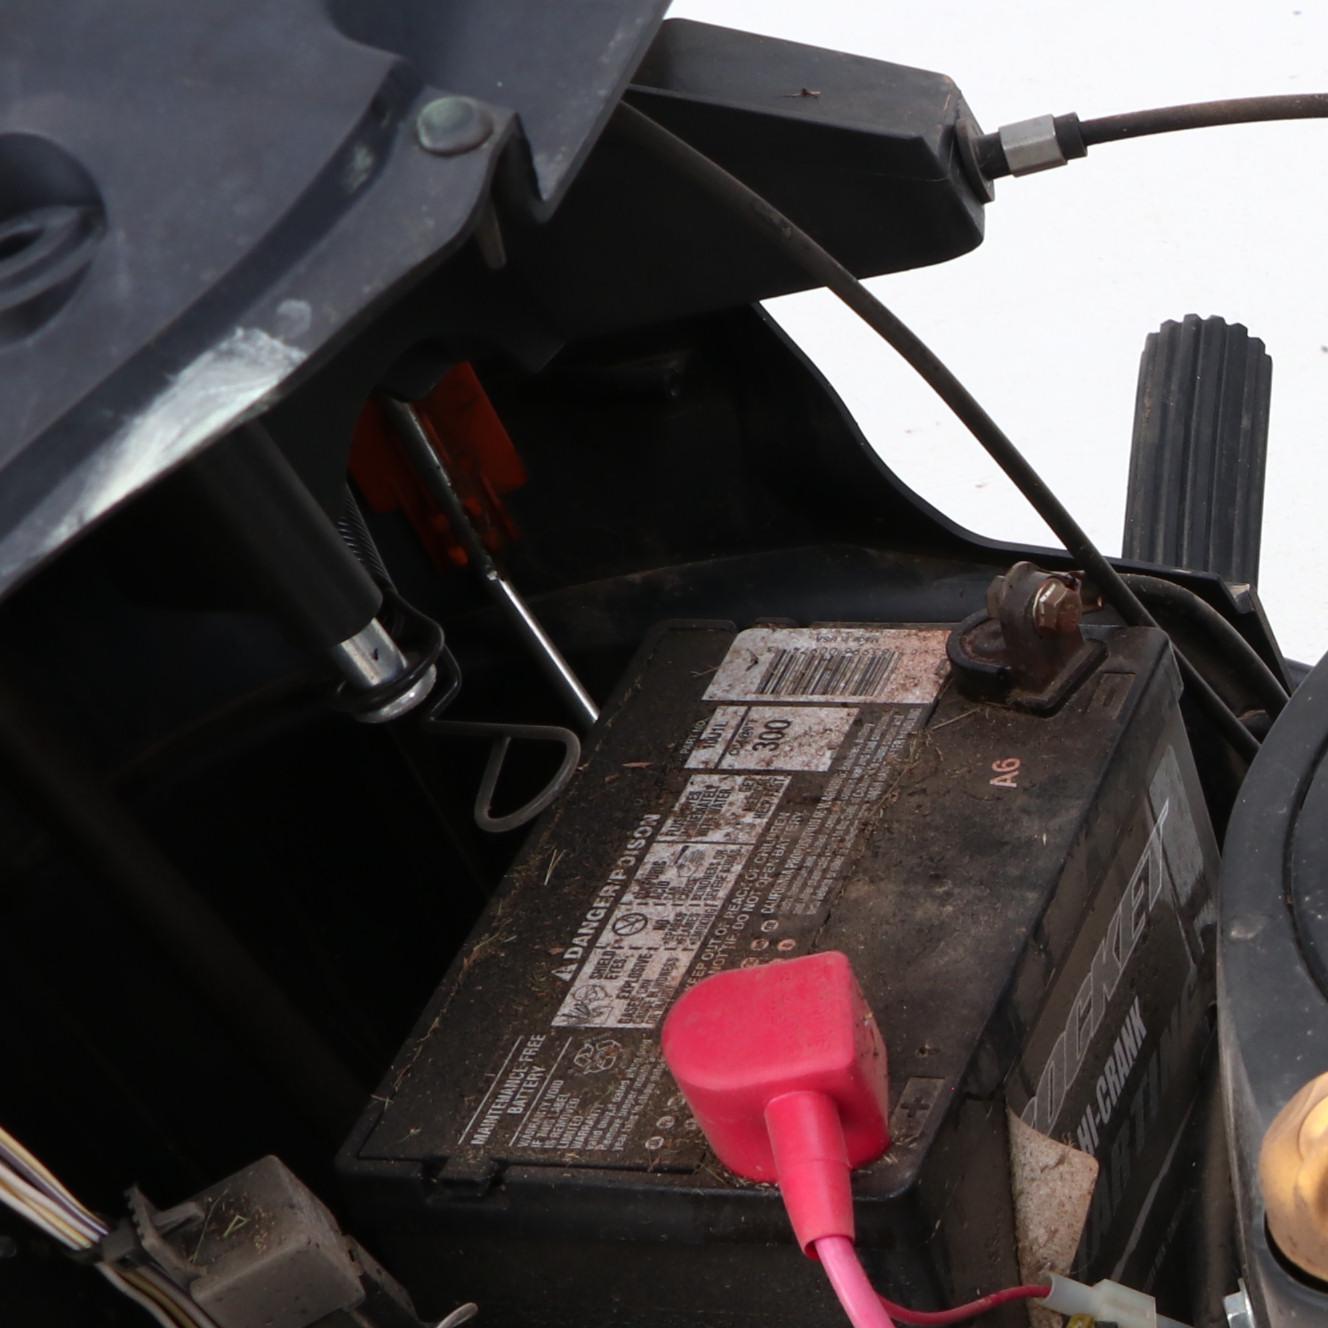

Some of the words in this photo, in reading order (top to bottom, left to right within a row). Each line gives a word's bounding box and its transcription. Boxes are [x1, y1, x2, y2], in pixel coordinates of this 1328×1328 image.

[752, 718, 790, 752] 300
[987, 756, 1021, 789] A6
[590, 951, 615, 978] SHIELD
[701, 937, 721, 959] OUT
[617, 953, 652, 998] EXPLOSIVE
[471, 1034, 545, 1144] MAINTENANCE-FREE
[508, 1066, 546, 1113] BATTERY
[1075, 994, 1148, 1156] HI-CRANK
[519, 1102, 550, 1145] WARRANTY
[545, 1080, 563, 1099] VOID
[548, 1093, 569, 1117] LABEL
[558, 1116, 582, 1147] LIMITED
